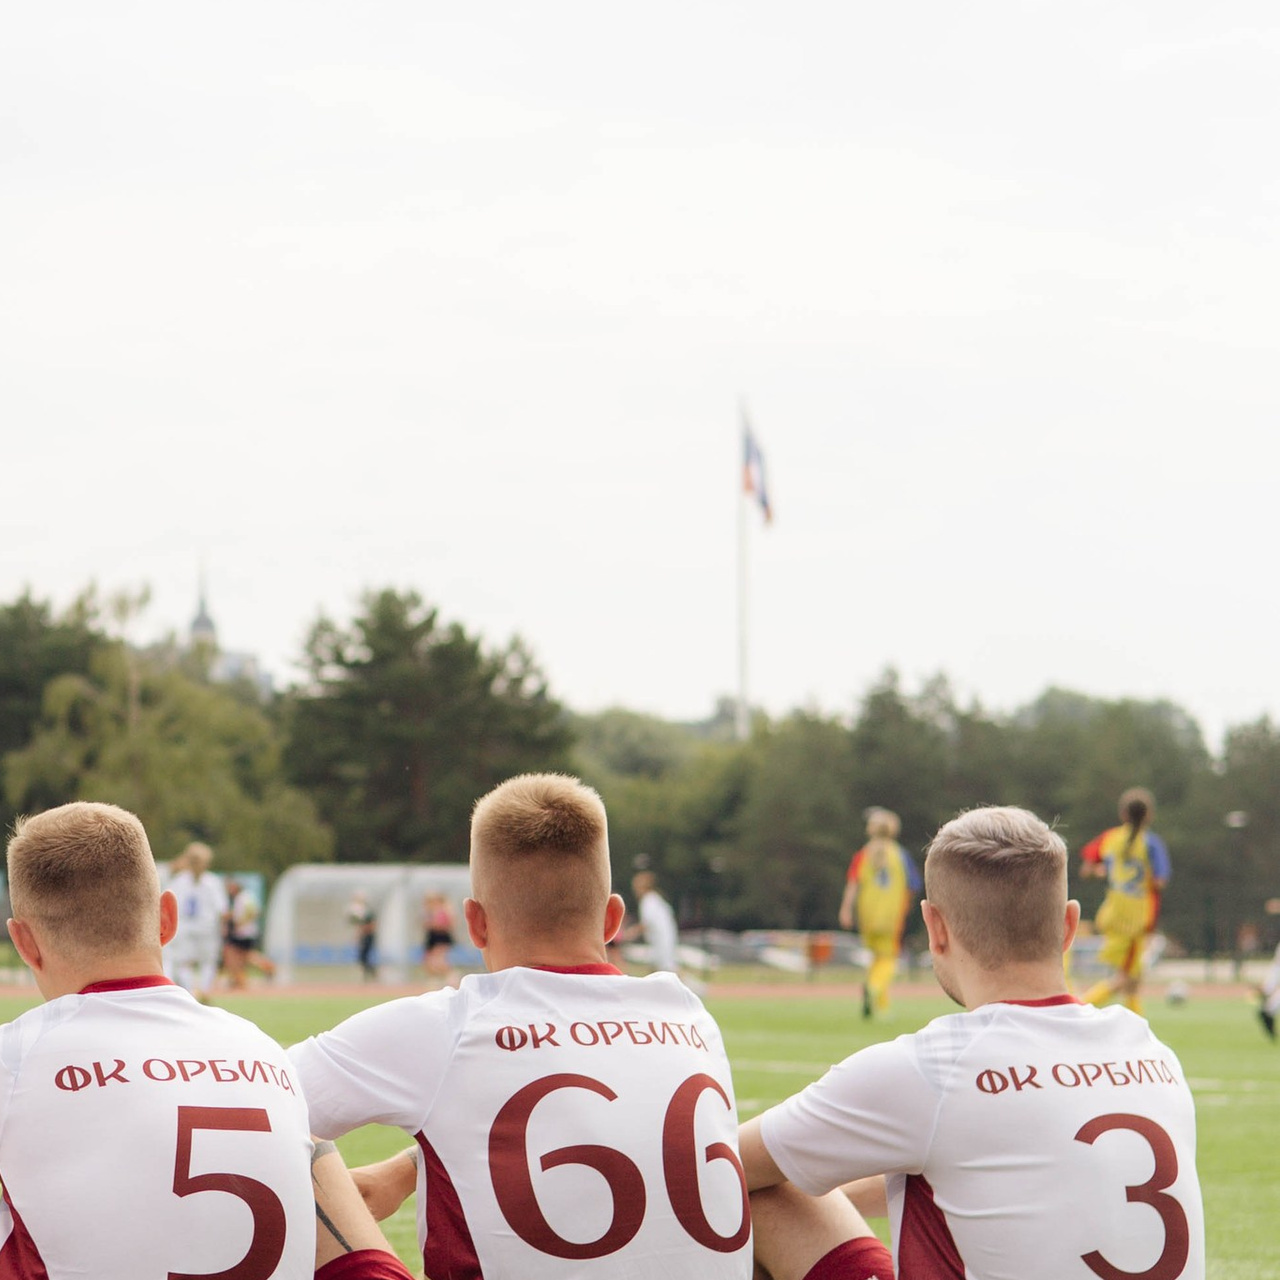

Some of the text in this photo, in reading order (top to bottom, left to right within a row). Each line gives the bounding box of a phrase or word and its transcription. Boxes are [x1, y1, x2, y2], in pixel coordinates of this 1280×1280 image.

[495, 1021, 708, 1052] ФК ОРБИТА
[54, 1058, 296, 1096] ФК ОРБИТА
[975, 1059, 1179, 1094] ФК ОРБИТА
[489, 1073, 753, 1260] 66
